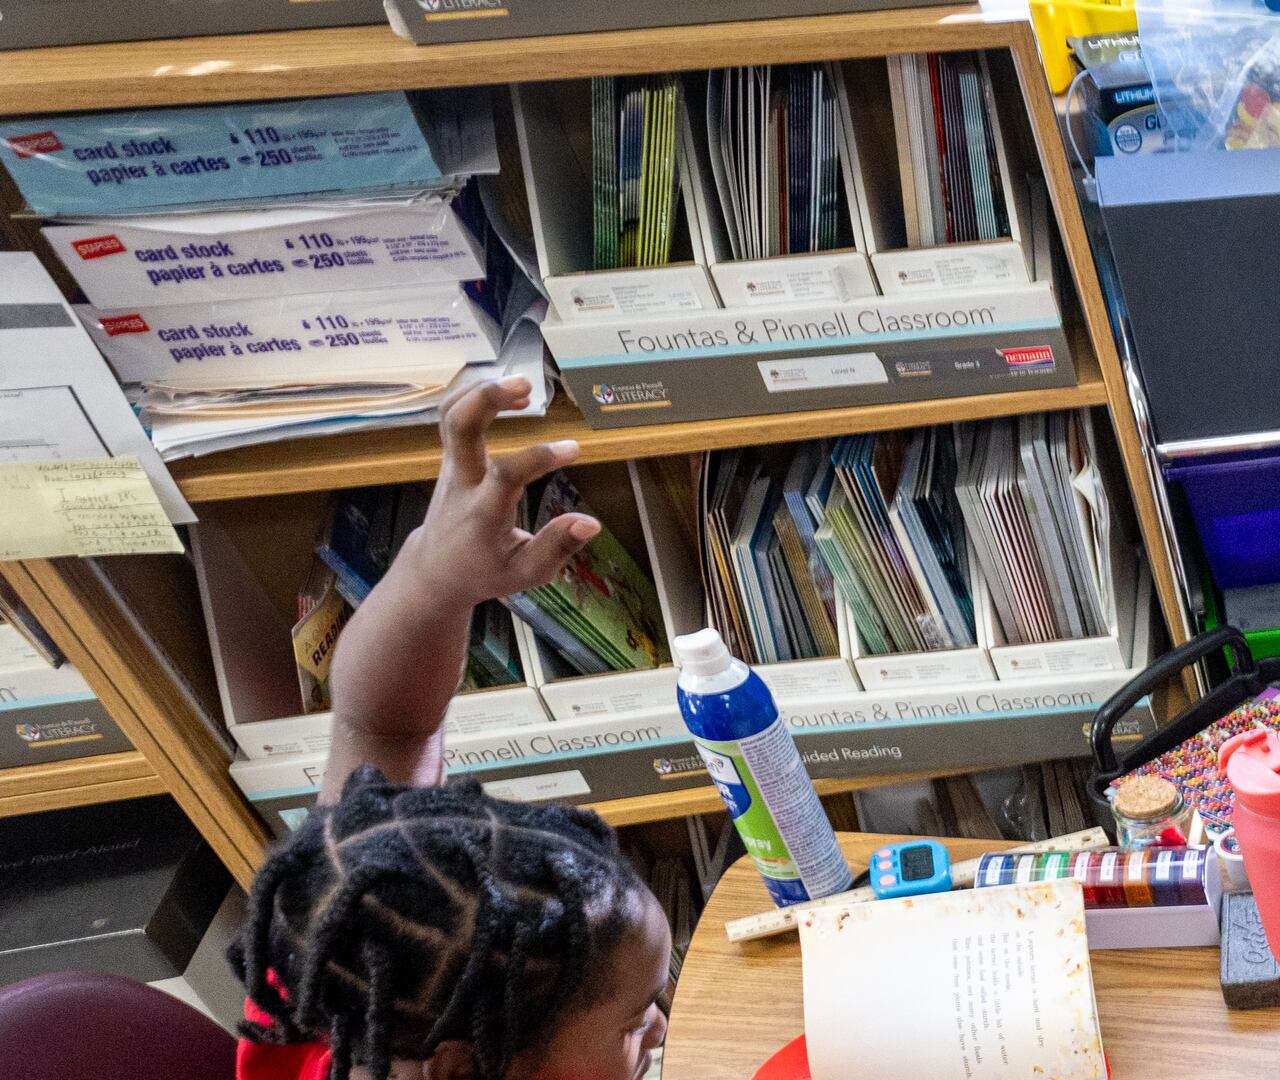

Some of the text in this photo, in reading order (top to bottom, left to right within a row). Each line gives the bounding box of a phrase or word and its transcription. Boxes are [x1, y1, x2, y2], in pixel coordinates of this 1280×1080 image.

[243, 127, 279, 144] 110
[73, 136, 176, 163] card stock
[256, 149, 292, 168] 250
[87, 156, 230, 186] papier à cartes
[77, 238, 121, 256] STAPLES
[298, 233, 333, 249] 110
[134, 240, 234, 263] card stock
[309, 252, 344, 268] 250
[147, 257, 284, 286] papier à cartes
[157, 321, 253, 342] card stock
[316, 315, 348, 331] 110
[617, 305, 996, 355] Fountas & Pinnell Classroom
[170, 336, 302, 363] papier à cartes
[325, 332, 360, 348] 250
[615, 385, 670, 403] LITERACY
[873, 703, 889, 721] &
[897, 697, 967, 719] Pinnell
[975, 692, 1093, 712] Classroom
[41, 724, 97, 739] LITERACY
[530, 726, 661, 756] Classroom
[841, 746, 902, 760] Reading
